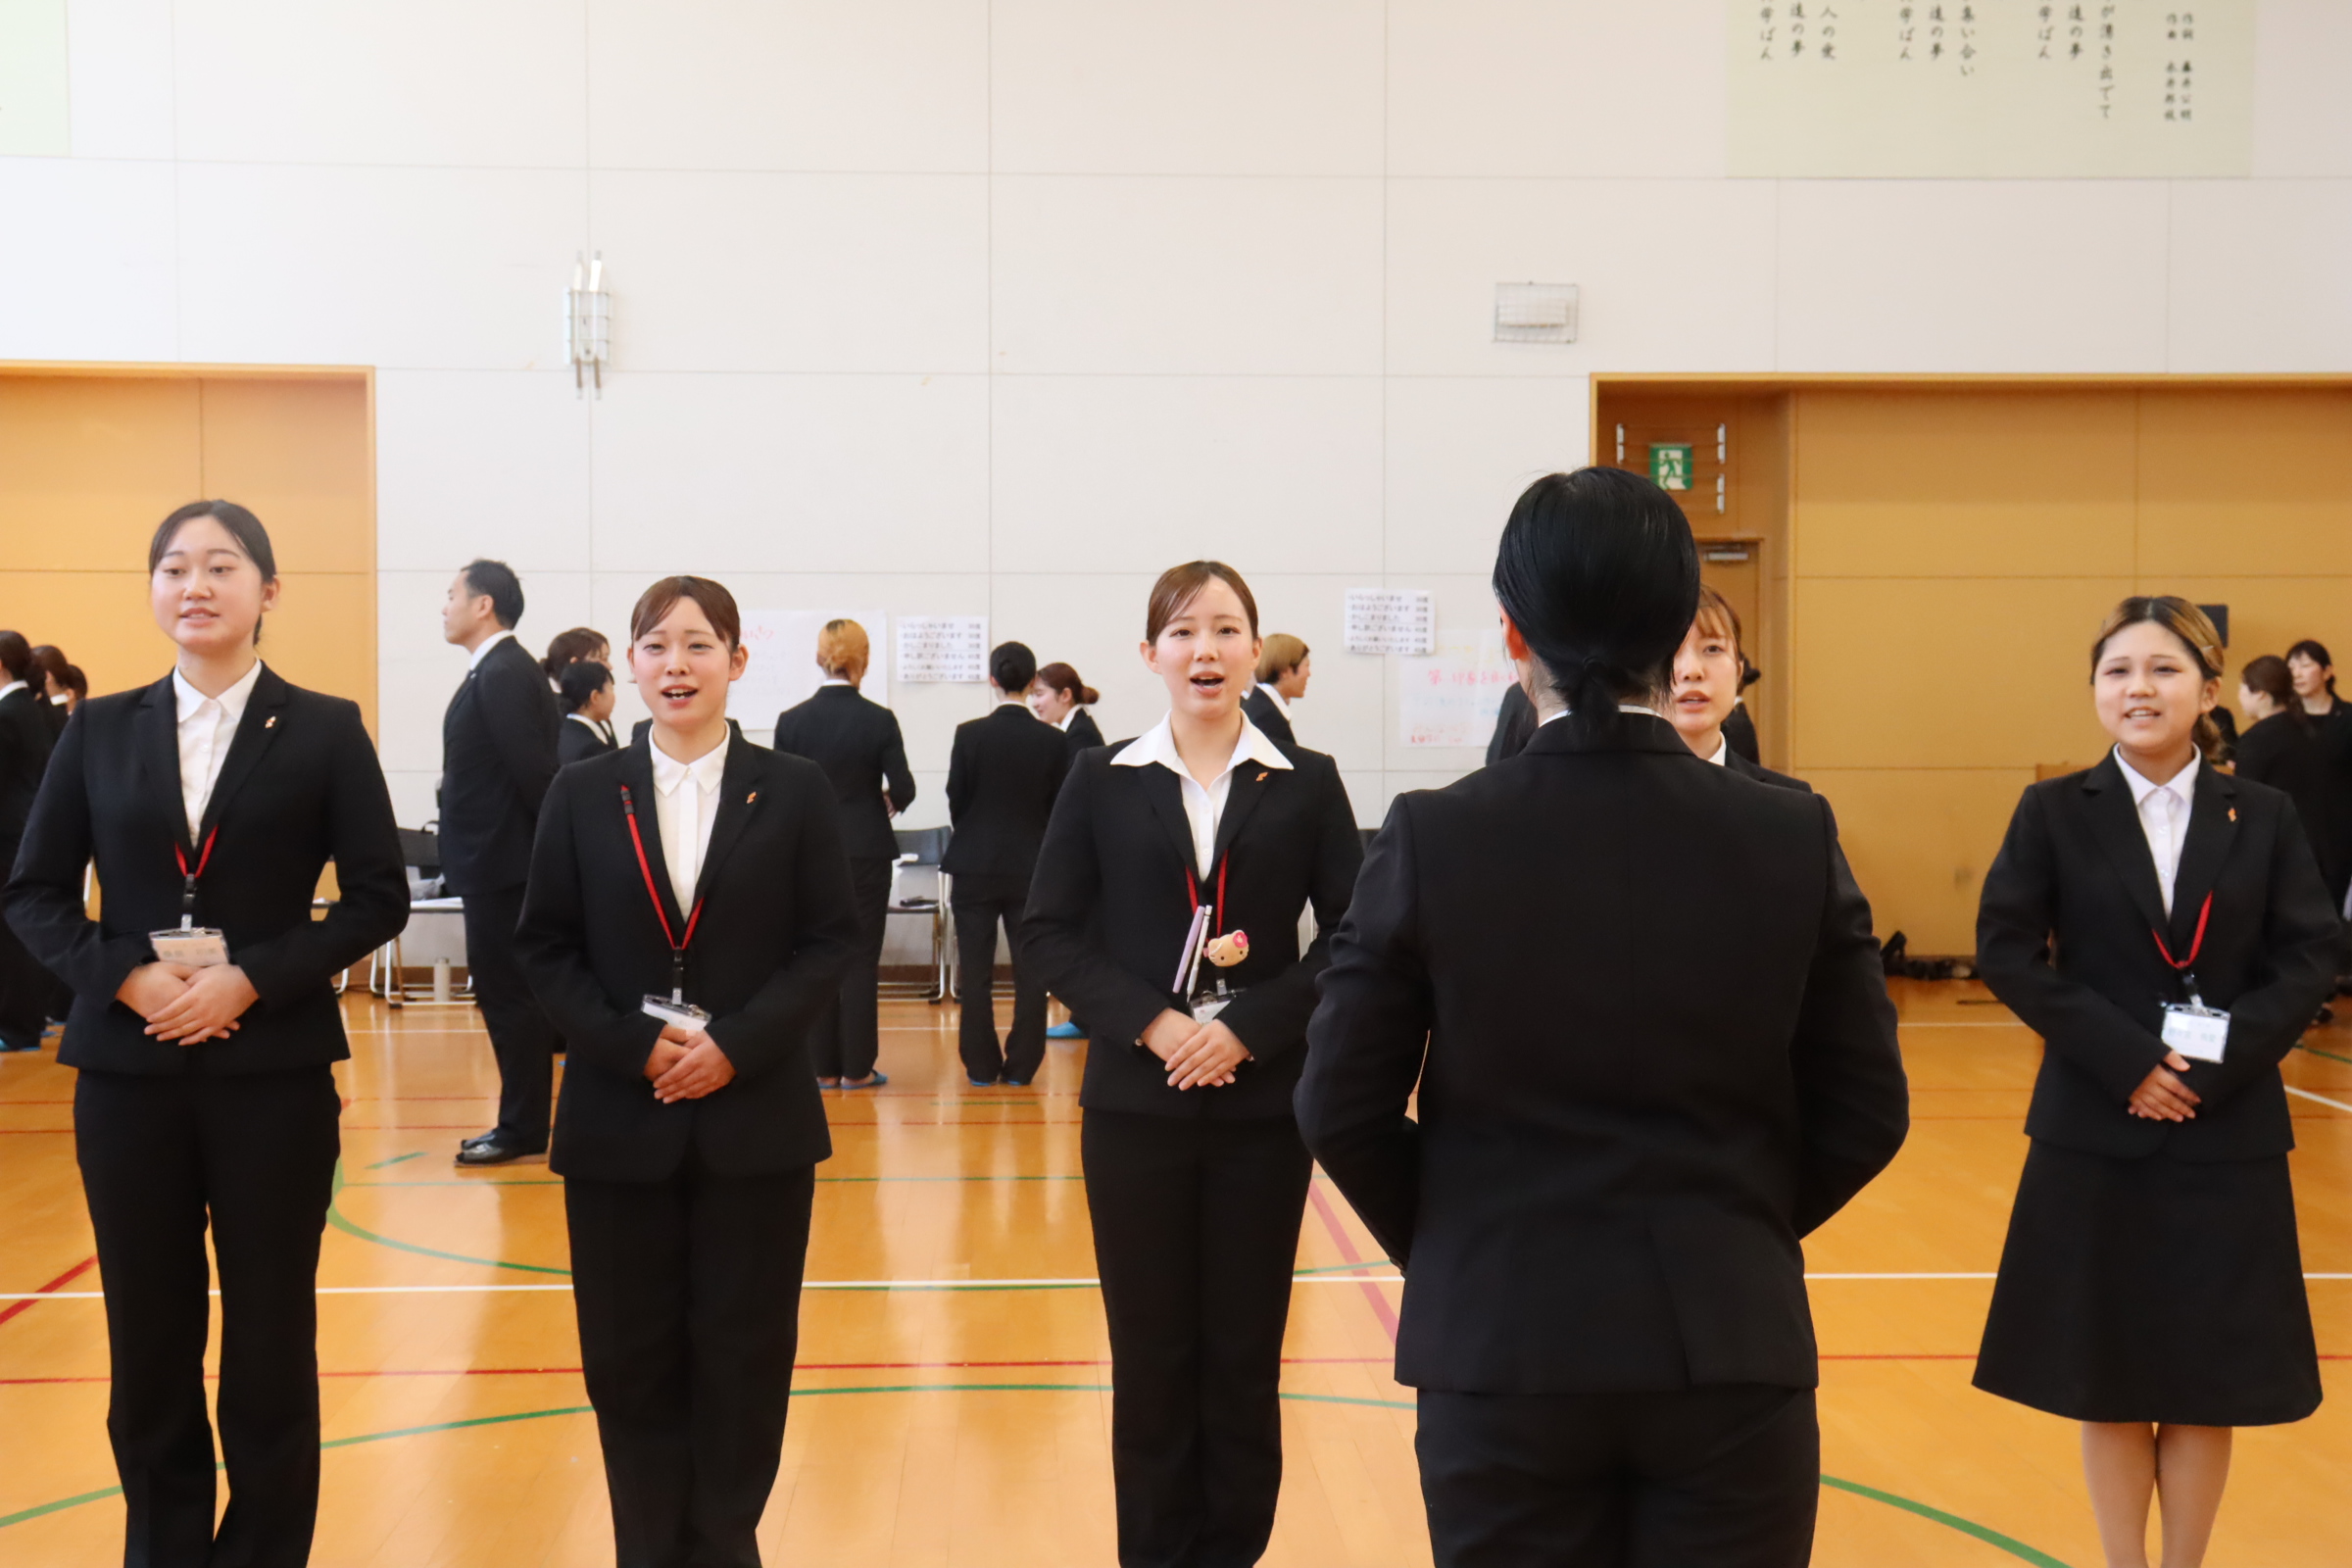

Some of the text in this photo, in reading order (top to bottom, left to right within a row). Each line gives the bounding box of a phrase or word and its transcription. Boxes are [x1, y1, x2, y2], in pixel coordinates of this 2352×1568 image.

[1760, 0, 1776, 60] 学ばん
[1899, 0, 1915, 60] 学ばん
[1961, 0, 1977, 76] 集い合い
[2038, 0, 2054, 60] 学ばん
[2099, 0, 2115, 119] が湧き出でて
